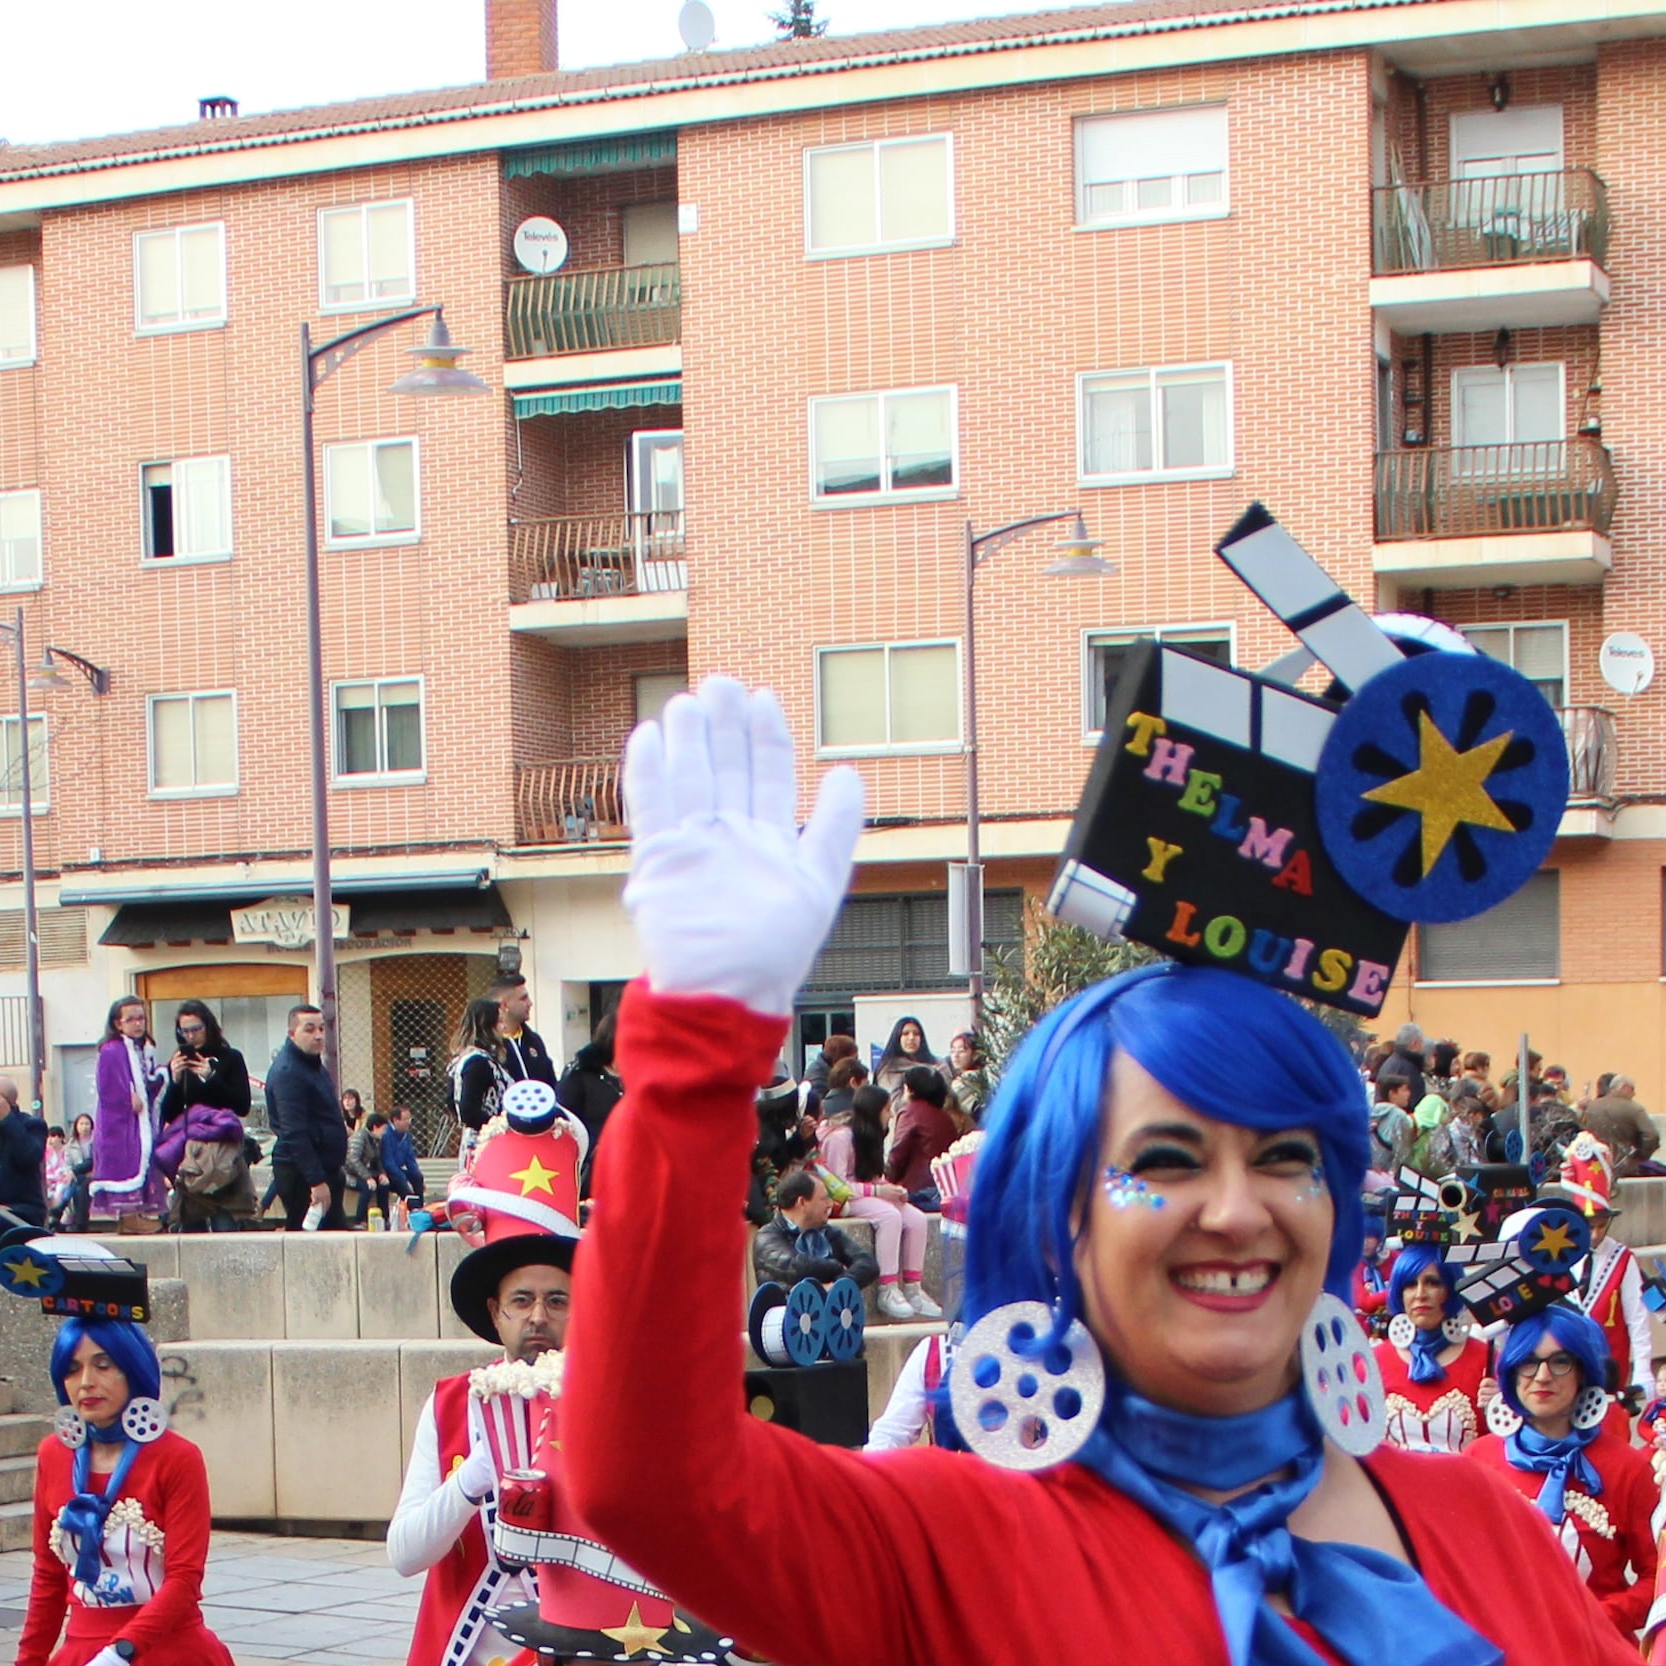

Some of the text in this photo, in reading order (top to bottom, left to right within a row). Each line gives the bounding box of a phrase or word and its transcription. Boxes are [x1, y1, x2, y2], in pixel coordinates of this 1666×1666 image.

[1124, 710, 1313, 897] THELMA
[1140, 836, 1183, 883] Y
[1164, 900, 1389, 1007] LOUISE
[42, 1296, 145, 1319] CARTOONS
[1489, 1283, 1534, 1316] LOVE
